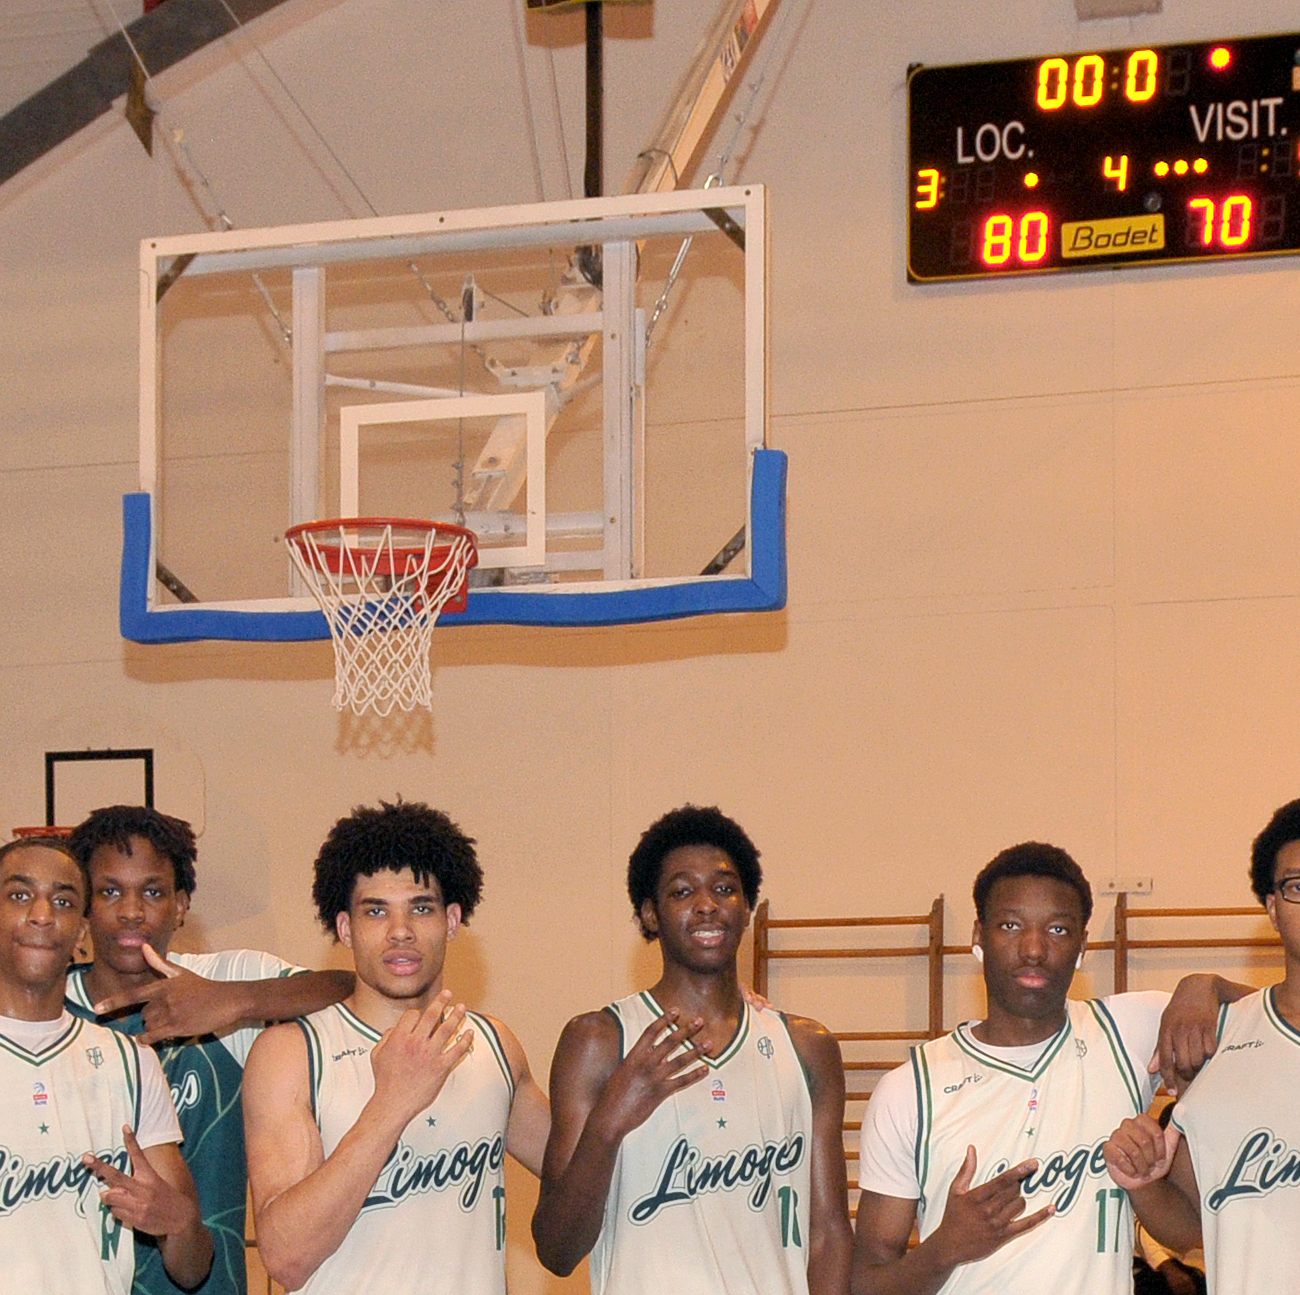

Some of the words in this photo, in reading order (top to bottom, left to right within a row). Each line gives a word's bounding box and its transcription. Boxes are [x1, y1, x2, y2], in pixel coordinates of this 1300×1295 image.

[1189, 97, 1288, 142] VISIT.
[956, 121, 1034, 164] LOC.
[915, 169, 940, 209] 3
[1103, 155, 1128, 191] 4
[982, 212, 1049, 265] 80
[1070, 224, 1159, 252] Bodet
[1189, 195, 1252, 246] 70
[632, 1136, 804, 1221] Limoges
[1096, 1188, 1125, 1253] 17
